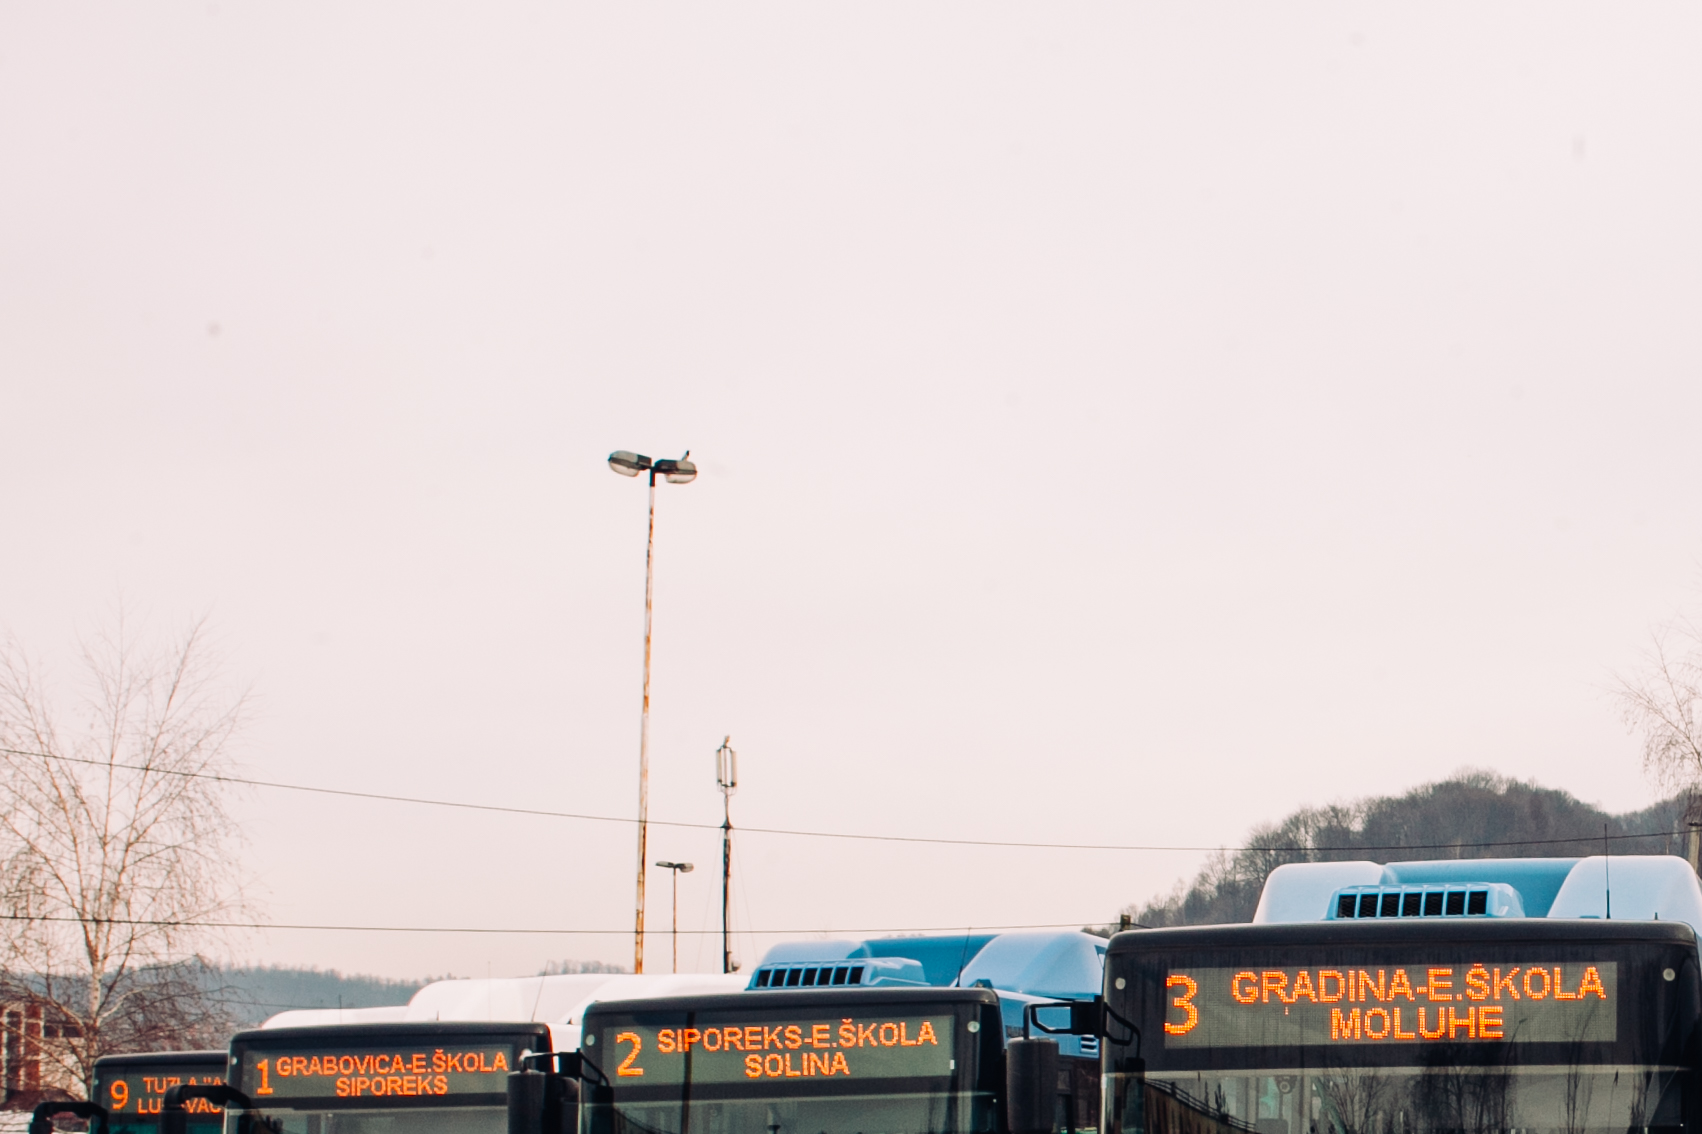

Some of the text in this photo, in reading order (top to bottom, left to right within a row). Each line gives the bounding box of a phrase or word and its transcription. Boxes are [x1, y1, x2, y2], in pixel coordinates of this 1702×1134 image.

[1231, 963, 1606, 1003] GRADINA-E.ŠKOLA
[1164, 974, 1198, 1036] 3
[657, 1018, 938, 1053] SIPOREKS-E.ŠKOLA
[1330, 1005, 1504, 1041] MOLUHE
[276, 1049, 508, 1076] GRABOVICA-E.ŠKOLA
[616, 1032, 644, 1077] 2
[744, 1051, 850, 1078] SOLINA
[110, 1080, 129, 1110] 9
[257, 1060, 273, 1095] 1
[336, 1075, 448, 1097] SIPOREKS
[137, 1097, 222, 1114] LUVAC
